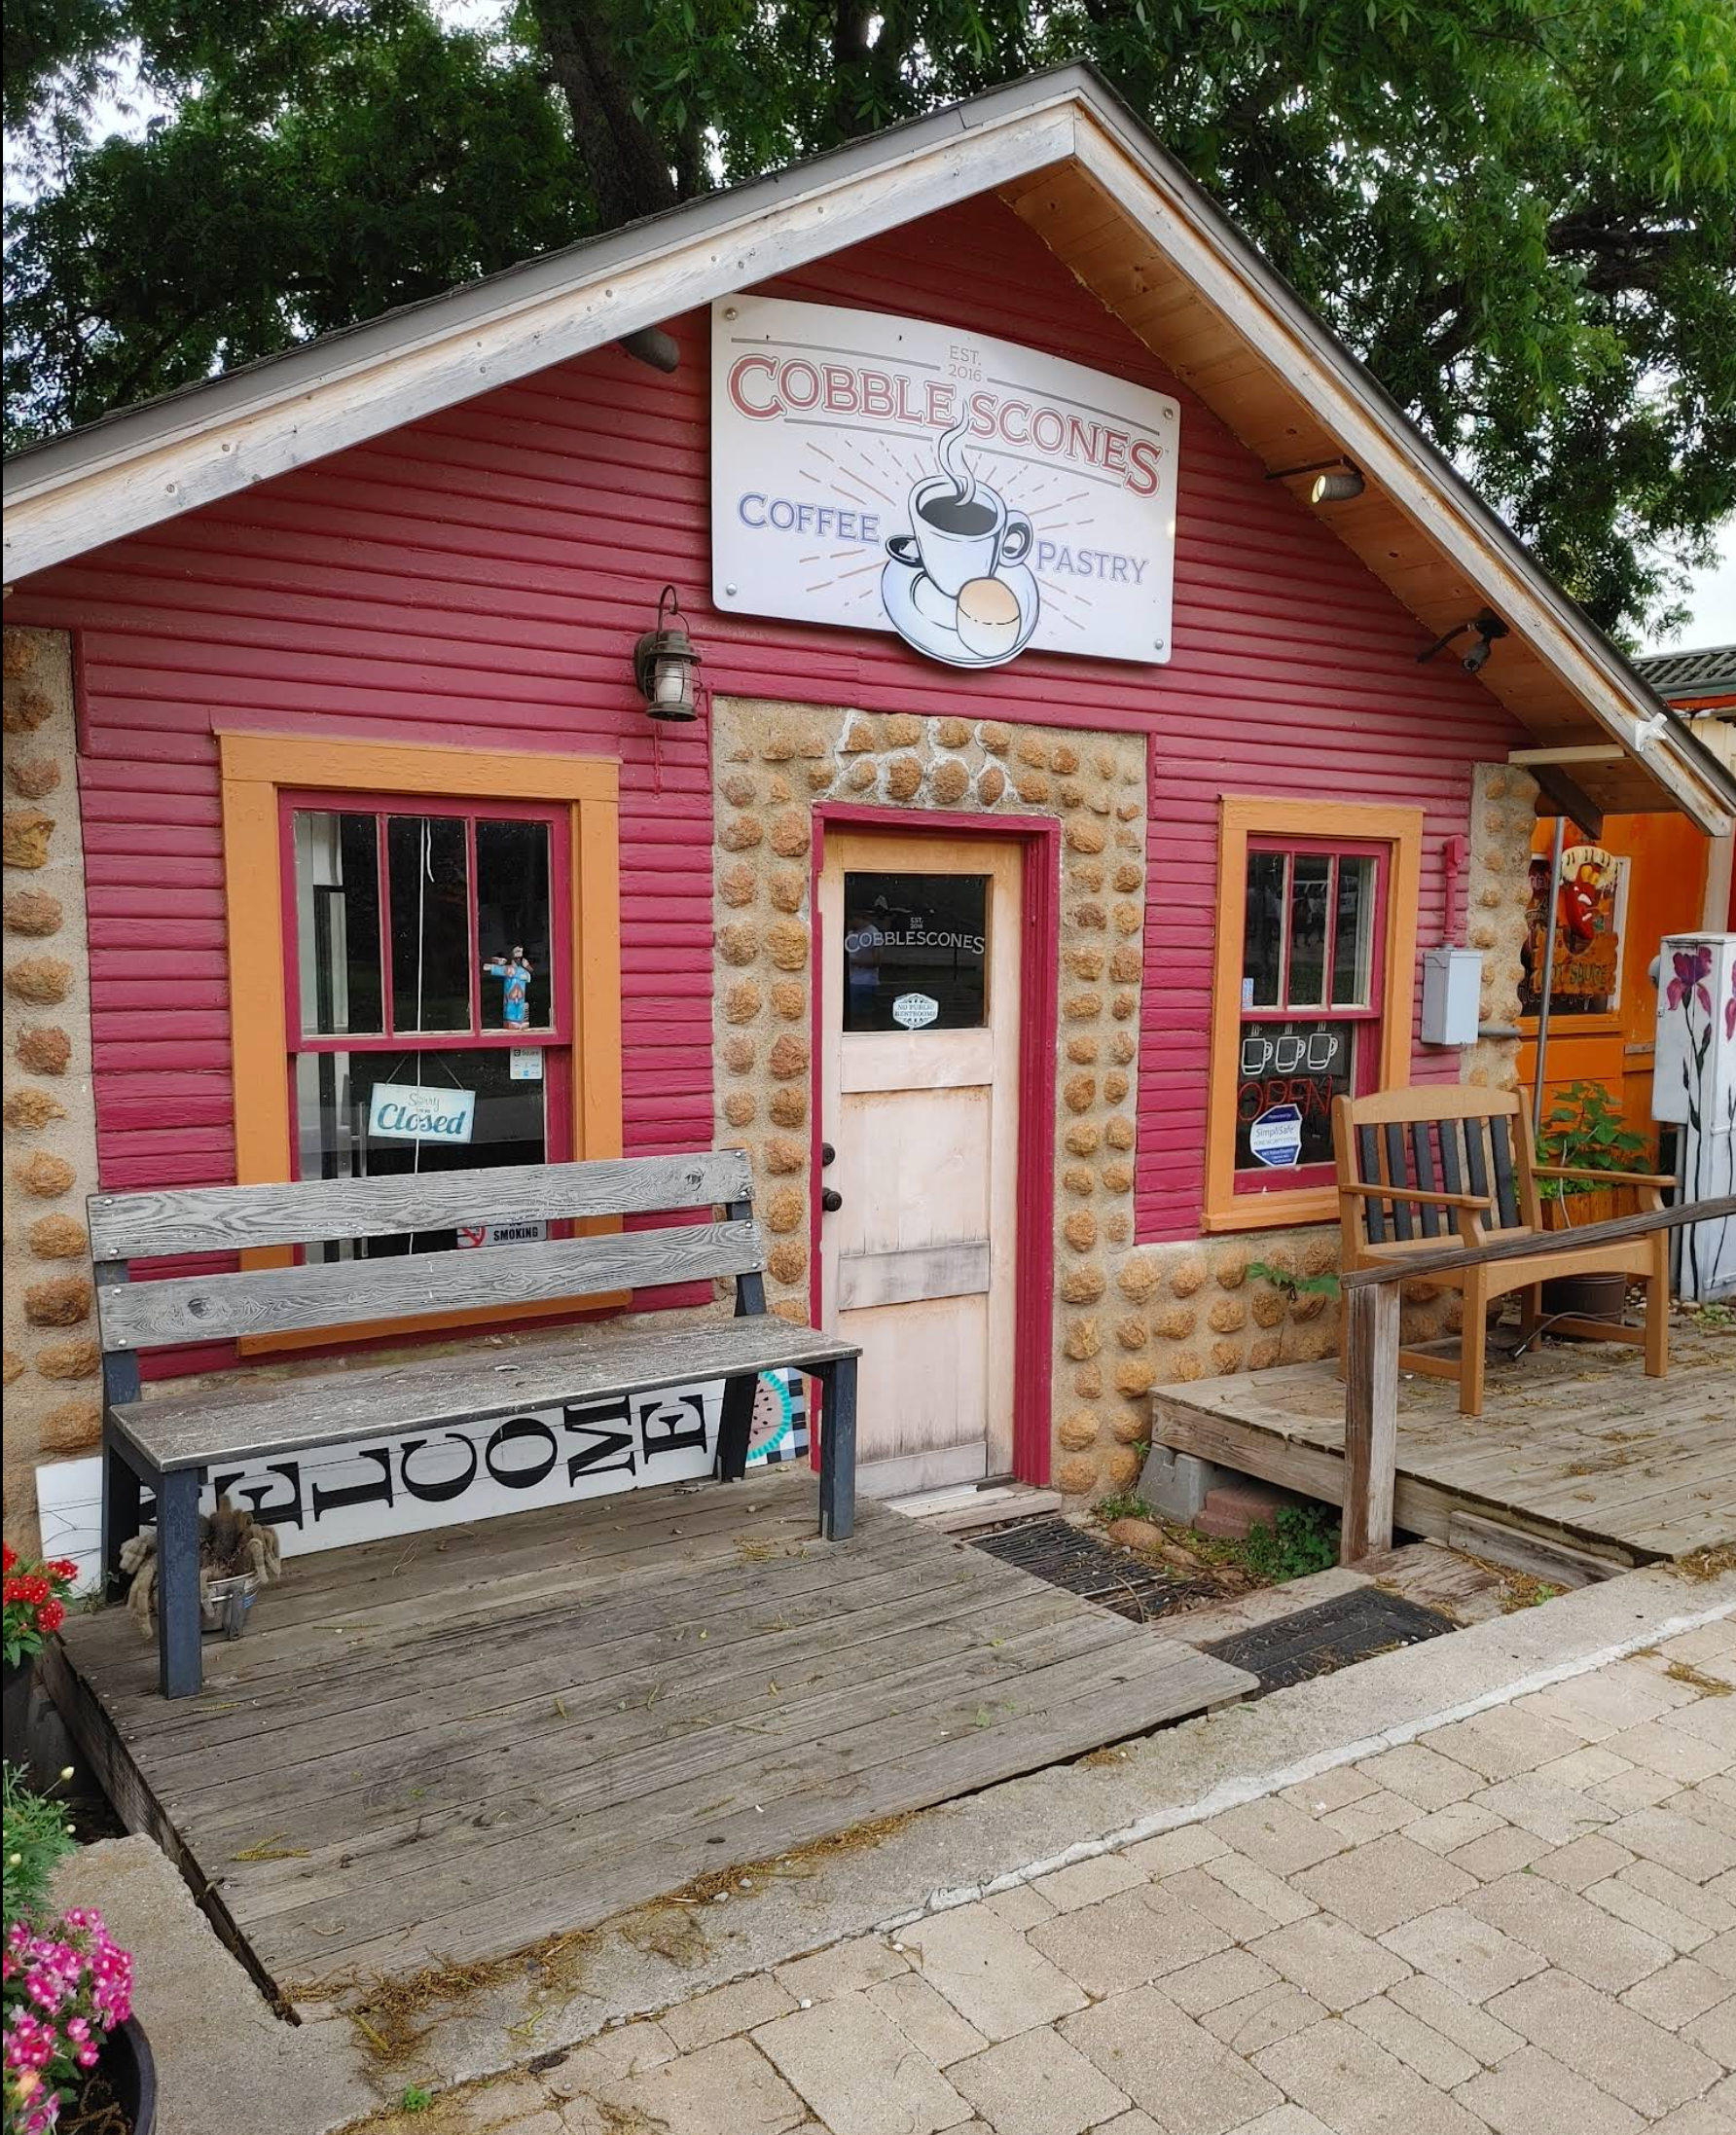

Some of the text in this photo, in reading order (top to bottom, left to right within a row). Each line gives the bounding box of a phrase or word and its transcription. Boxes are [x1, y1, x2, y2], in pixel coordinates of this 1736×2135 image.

[949, 344, 982, 365] EST.
[948, 364, 982, 382] 2016
[727, 353, 1164, 498] COBBLE SCONES
[738, 492, 882, 544] COFFEE
[1035, 541, 1150, 584] PASTRY
[845, 931, 985, 954] COBBLESCONES
[409, 1092, 440, 1112] Sorry
[1239, 1074, 1334, 1121] OPEN
[378, 1104, 467, 1135] Closed
[493, 1226, 538, 1242] SMOKING
